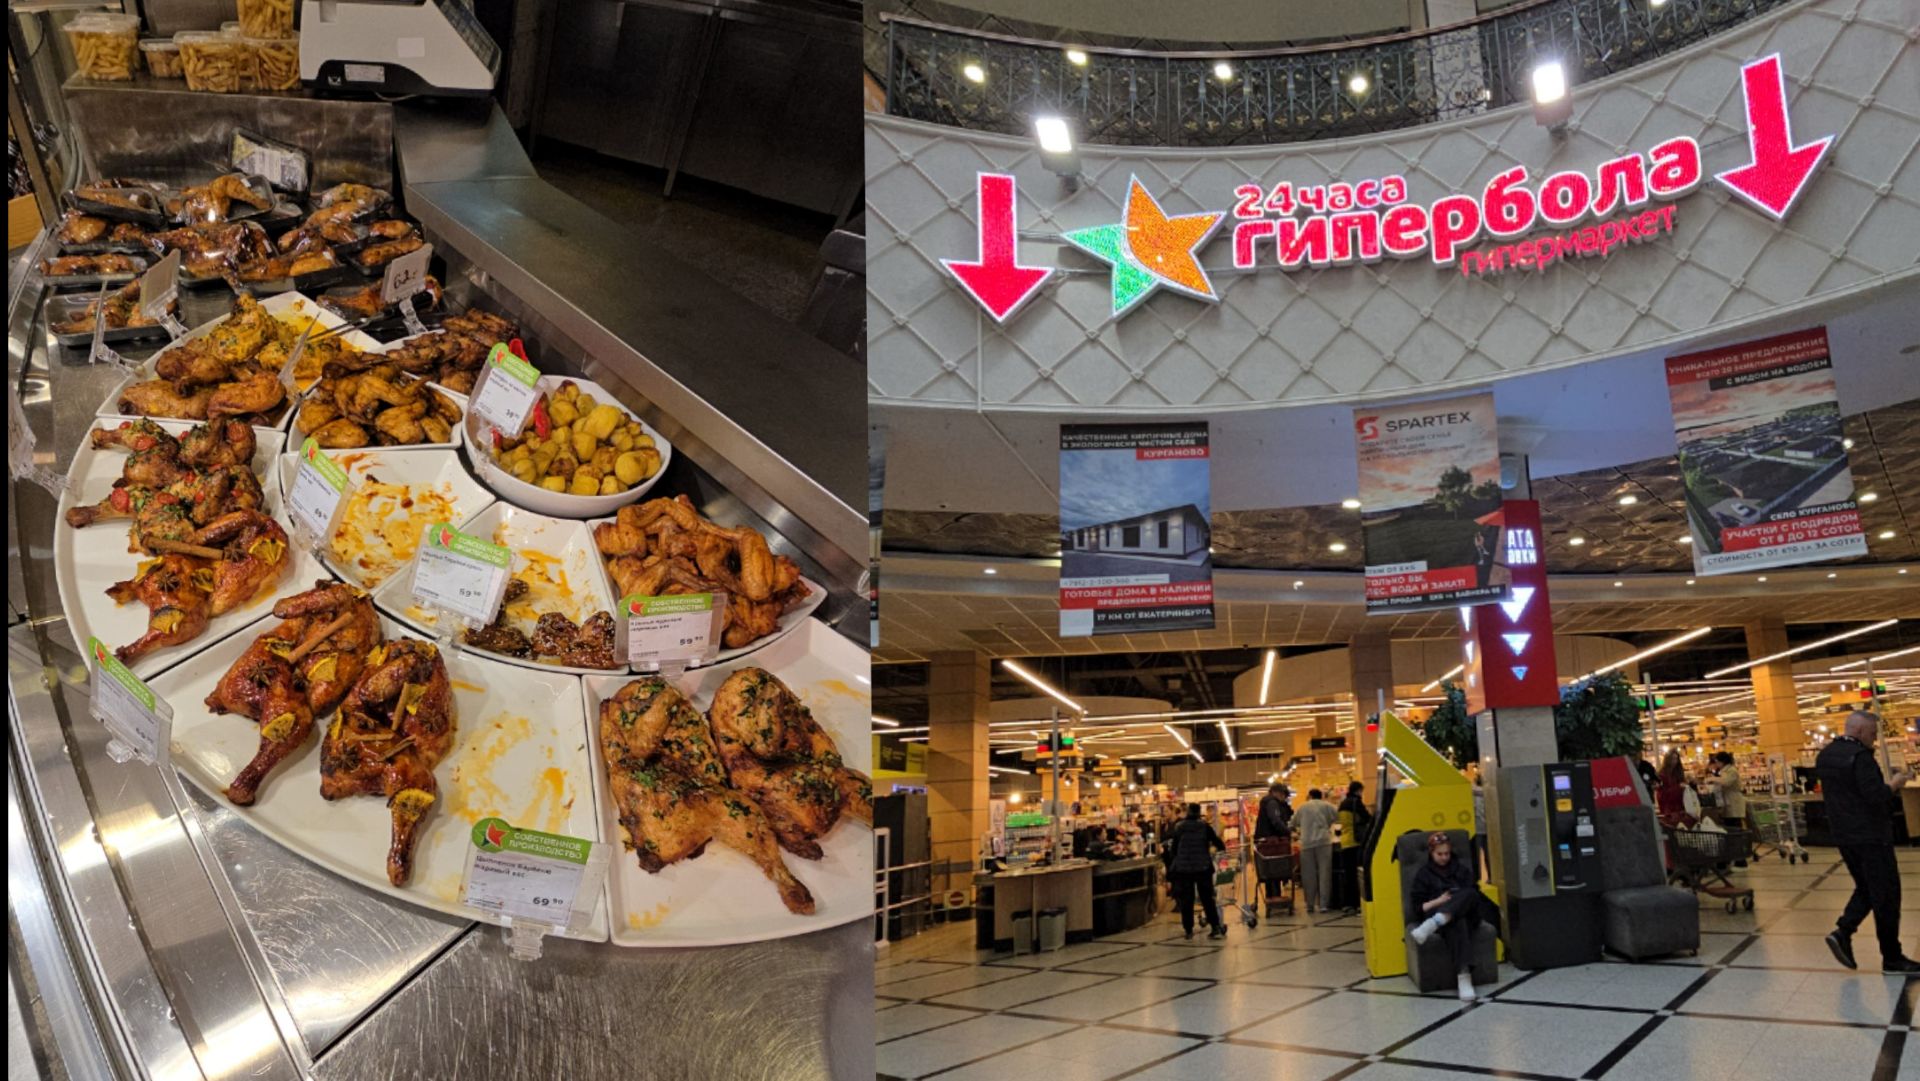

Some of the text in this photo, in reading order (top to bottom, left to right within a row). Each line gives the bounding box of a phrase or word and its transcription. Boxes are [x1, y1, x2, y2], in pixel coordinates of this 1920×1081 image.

[1232, 135, 1702, 269] гипербола
[1461, 203, 1678, 276] гипермаркет
[1668, 337, 1825, 375] УНИКАЛЬНОЕ ПРЕДЛОЖЕНИЕ
[1735, 371, 1769, 384] ВИДОМ
[1771, 368, 1784, 377] НА
[1787, 360, 1828, 374] ВОДОЕМ
[1385, 411, 1472, 432] SPARTEX
[1130, 432, 1181, 440] КИРПИЧНЫЕ
[1143, 448, 1204, 458] КУРГАНОВО
[1770, 502, 1856, 521] СЕЛО КУРГАНОВО
[1727, 514, 1858, 540] УЧАСТКИ С ПОДРЯДОМ
[1759, 535, 1774, 544] ОТ
[1787, 532, 1804, 543] ДО
[1821, 523, 1861, 536] СОТОК
[1707, 552, 1763, 566] СТОИМОСТЬ
[1766, 548, 1778, 556] ОТ
[1816, 541, 1828, 550] ЗА
[1830, 536, 1861, 547] СОТКУ
[1367, 576, 1405, 586] ТОЛЬКО
[1391, 584, 1419, 593] ВОДА
[1422, 583, 1429, 591] И
[1064, 584, 1212, 598] ГОТОВЫЕ ДОМА В НАЛИЧИИ
[1390, 596, 1422, 604] ПРОДАЖ
[1097, 608, 1212, 621] 17 КМ ОТ ЕКАТЕРИНБУРГА
[509, 840, 582, 859] ПРОИЗВОДСТВО
[514, 832, 581, 851] СОБСТВЕННОЕ
[532, 896, 550, 906] 69
